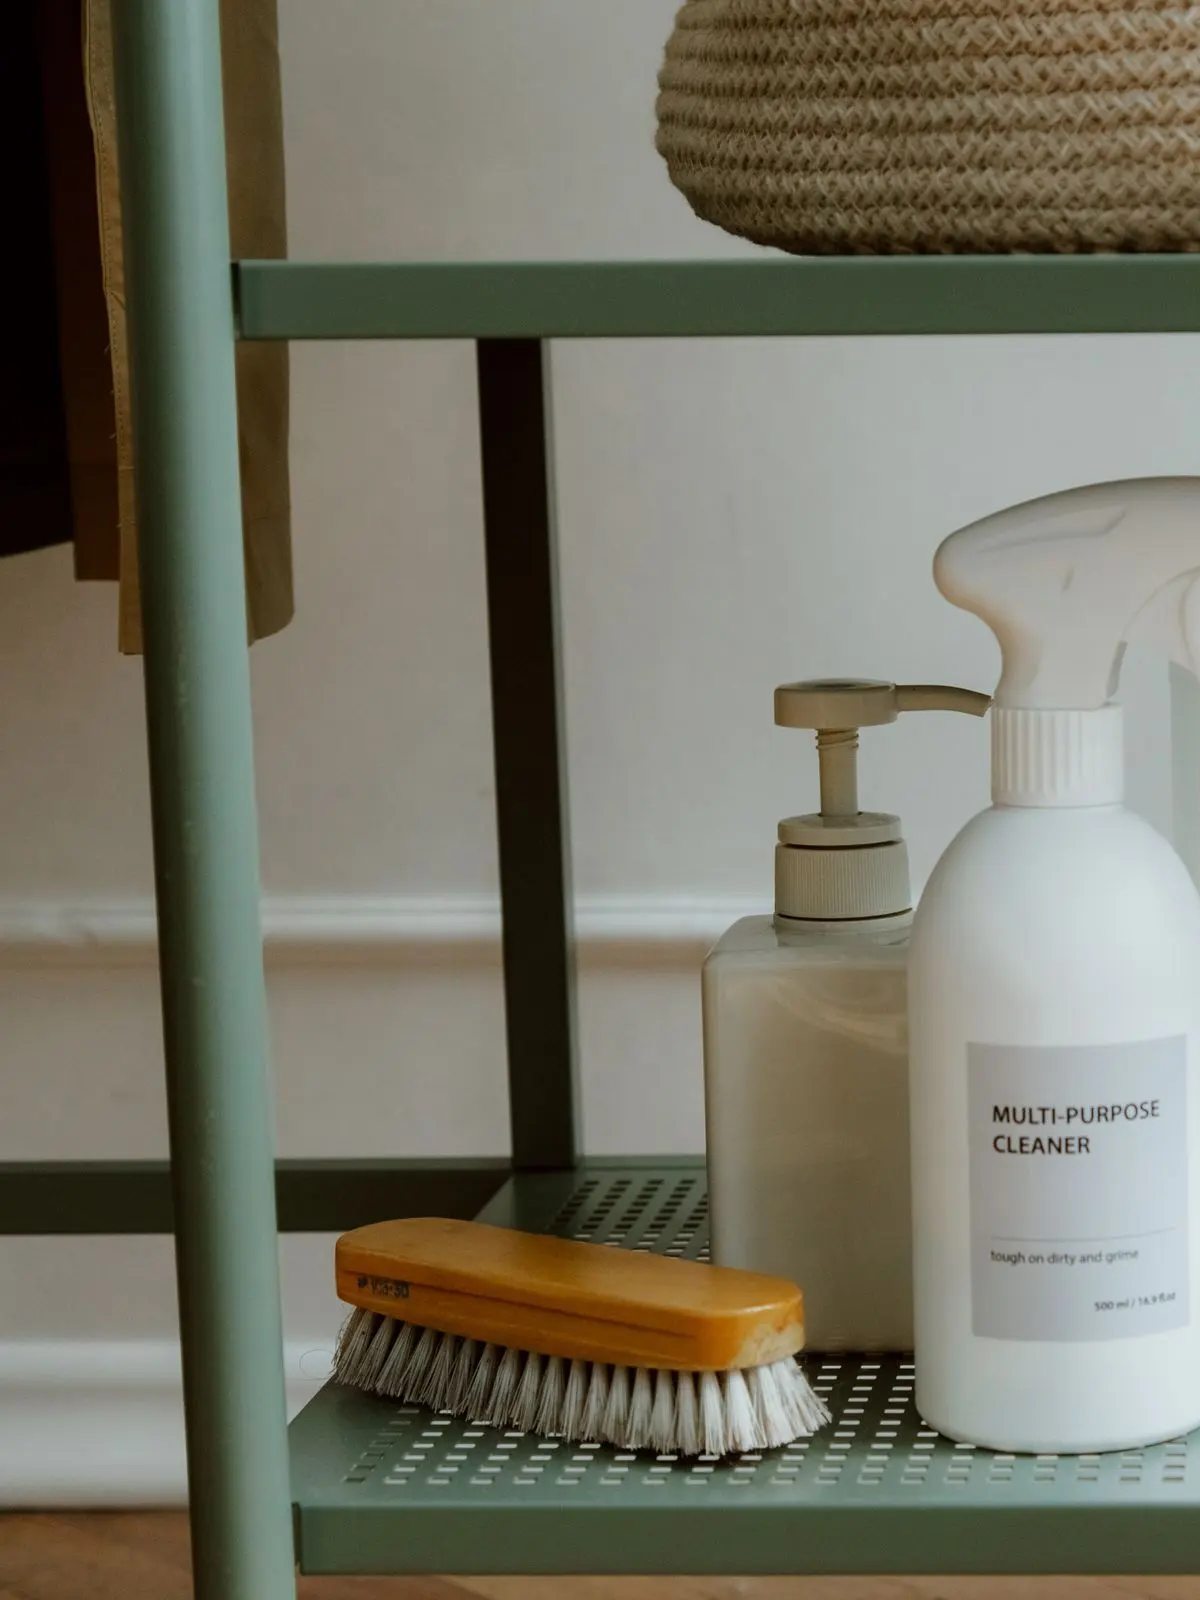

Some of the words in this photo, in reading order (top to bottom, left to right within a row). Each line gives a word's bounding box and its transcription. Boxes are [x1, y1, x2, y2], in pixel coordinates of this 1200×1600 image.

[992, 1100, 1160, 1124] MULTI-PURPOSE
[993, 1135, 1091, 1154] CLEANER
[991, 1250, 1025, 1265] tough
[1029, 1253, 1044, 1264] on
[1047, 1252, 1076, 1266] dirty
[1080, 1252, 1102, 1263] and
[1106, 1249, 1139, 1264] grime
[1095, 1301, 1114, 1311] 500
[1116, 1298, 1129, 1309] ml
